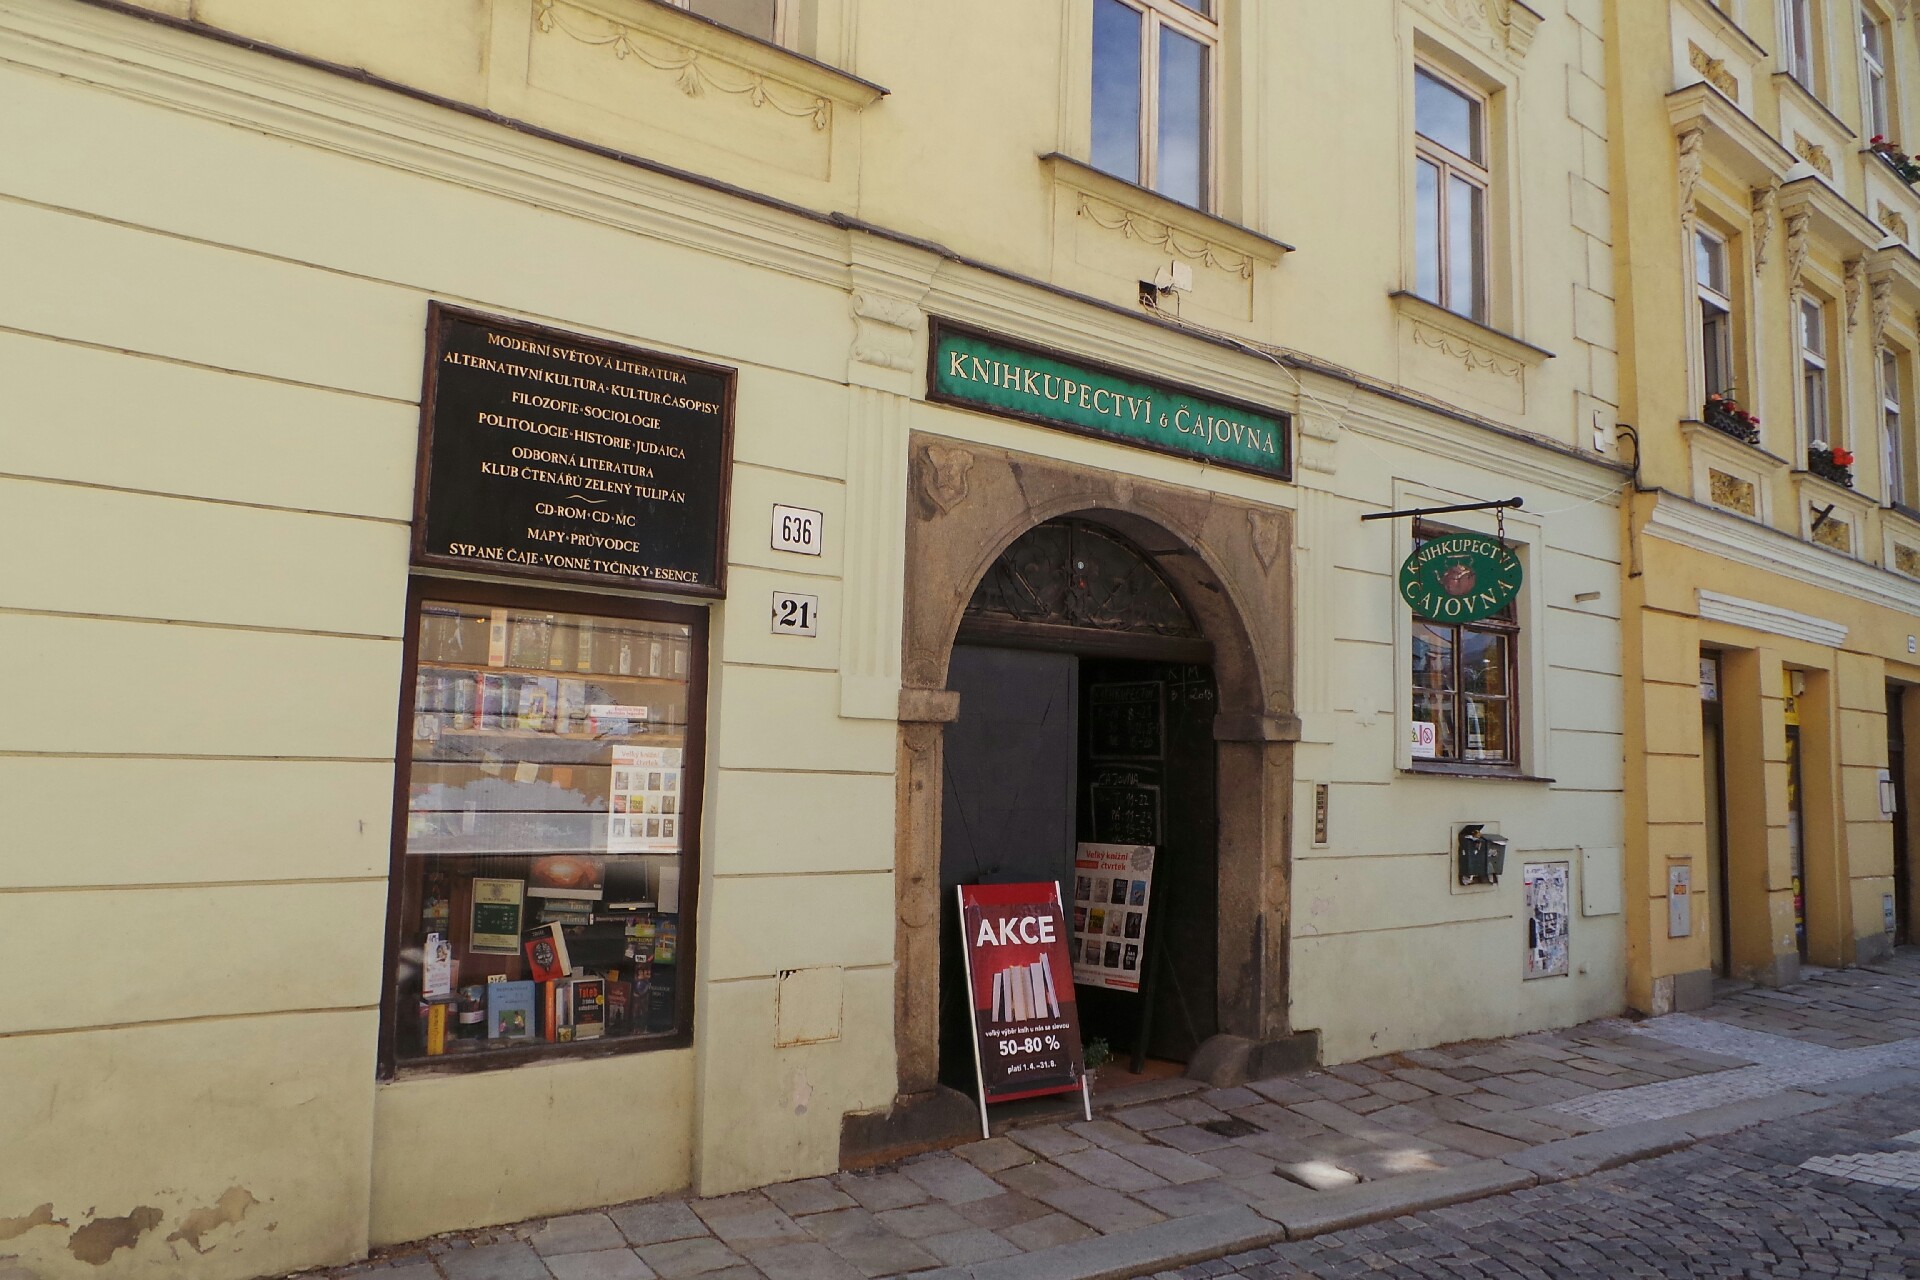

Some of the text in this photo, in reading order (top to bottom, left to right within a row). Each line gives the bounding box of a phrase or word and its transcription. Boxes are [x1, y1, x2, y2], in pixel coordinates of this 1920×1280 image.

[444, 351, 543, 381] ALTERNATIVNÍ
[545, 372, 605, 393] KULTURA
[488, 332, 687, 384] MODERNÍ SVĚTOVÁ LITERATURA
[512, 391, 661, 430] FILOZOFIE SOCIOLOGIE
[949, 351, 1152, 425] KNIHKUPECTVÍ
[1174, 405, 1276, 455] ČAJOVNA
[478, 412, 686, 459] POLITOLOGIE HISTORIE JUDAICA
[512, 446, 654, 478] ODBORNÁ LITERATURA
[481, 461, 686, 503] KLUB ČTENÁŘŮ ZELENÝ TULIPÁN
[536, 502, 636, 527] CD-ROM CD MC
[783, 516, 811, 544] 636
[527, 527, 640, 553] MAPY PRŮVODCE
[1406, 539, 1520, 575] KNIHKUPECTVÍ
[449, 543, 698, 583] SYPANÉ ČAJE VONNÉ TYČINKY ESENCE
[780, 600, 809, 628] 21
[976, 916, 1056, 947] AKCE
